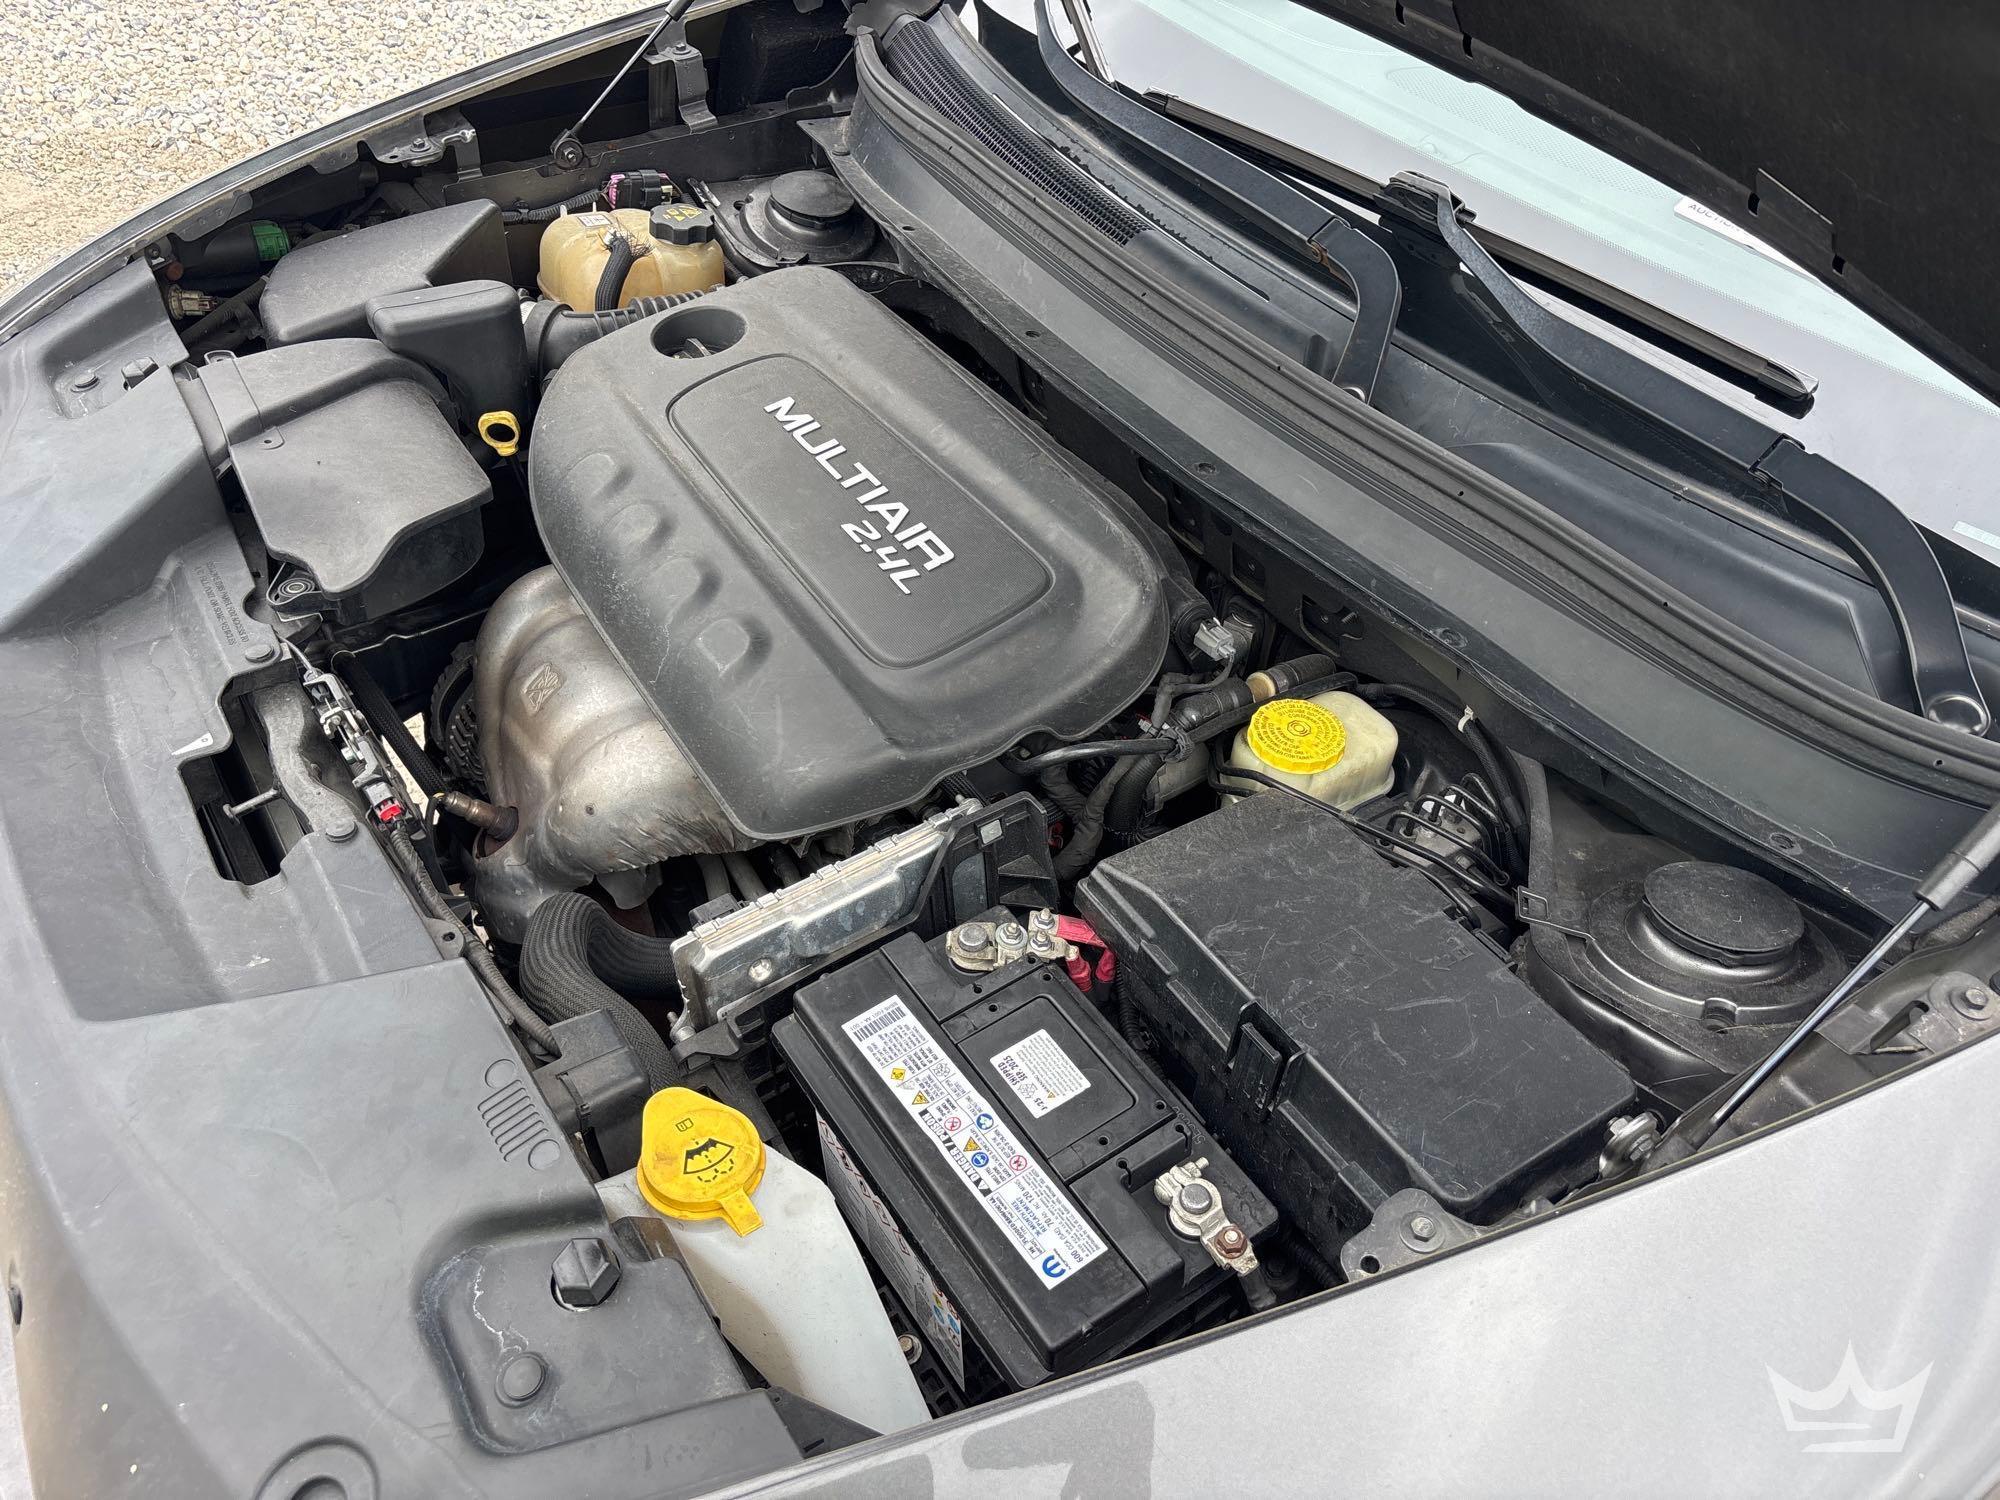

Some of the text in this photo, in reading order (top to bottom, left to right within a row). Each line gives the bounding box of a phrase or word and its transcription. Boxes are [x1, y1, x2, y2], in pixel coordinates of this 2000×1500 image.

[763, 396, 954, 571] MULTIAIR
[841, 520, 920, 594] 2.4L
[996, 1061, 1019, 1085] SHIPPED
[1003, 1055, 1018, 1069] 2025
[1014, 1068, 1027, 1081] SEP.
[921, 1112, 948, 1141] POISON
[949, 1146, 980, 1181] DANGER
[1022, 1190, 1034, 1203] 120
[1015, 1195, 1047, 1232] REPLACEMENT
[1044, 1217, 1054, 1226] 70
[1070, 1249, 1083, 1263] 600
